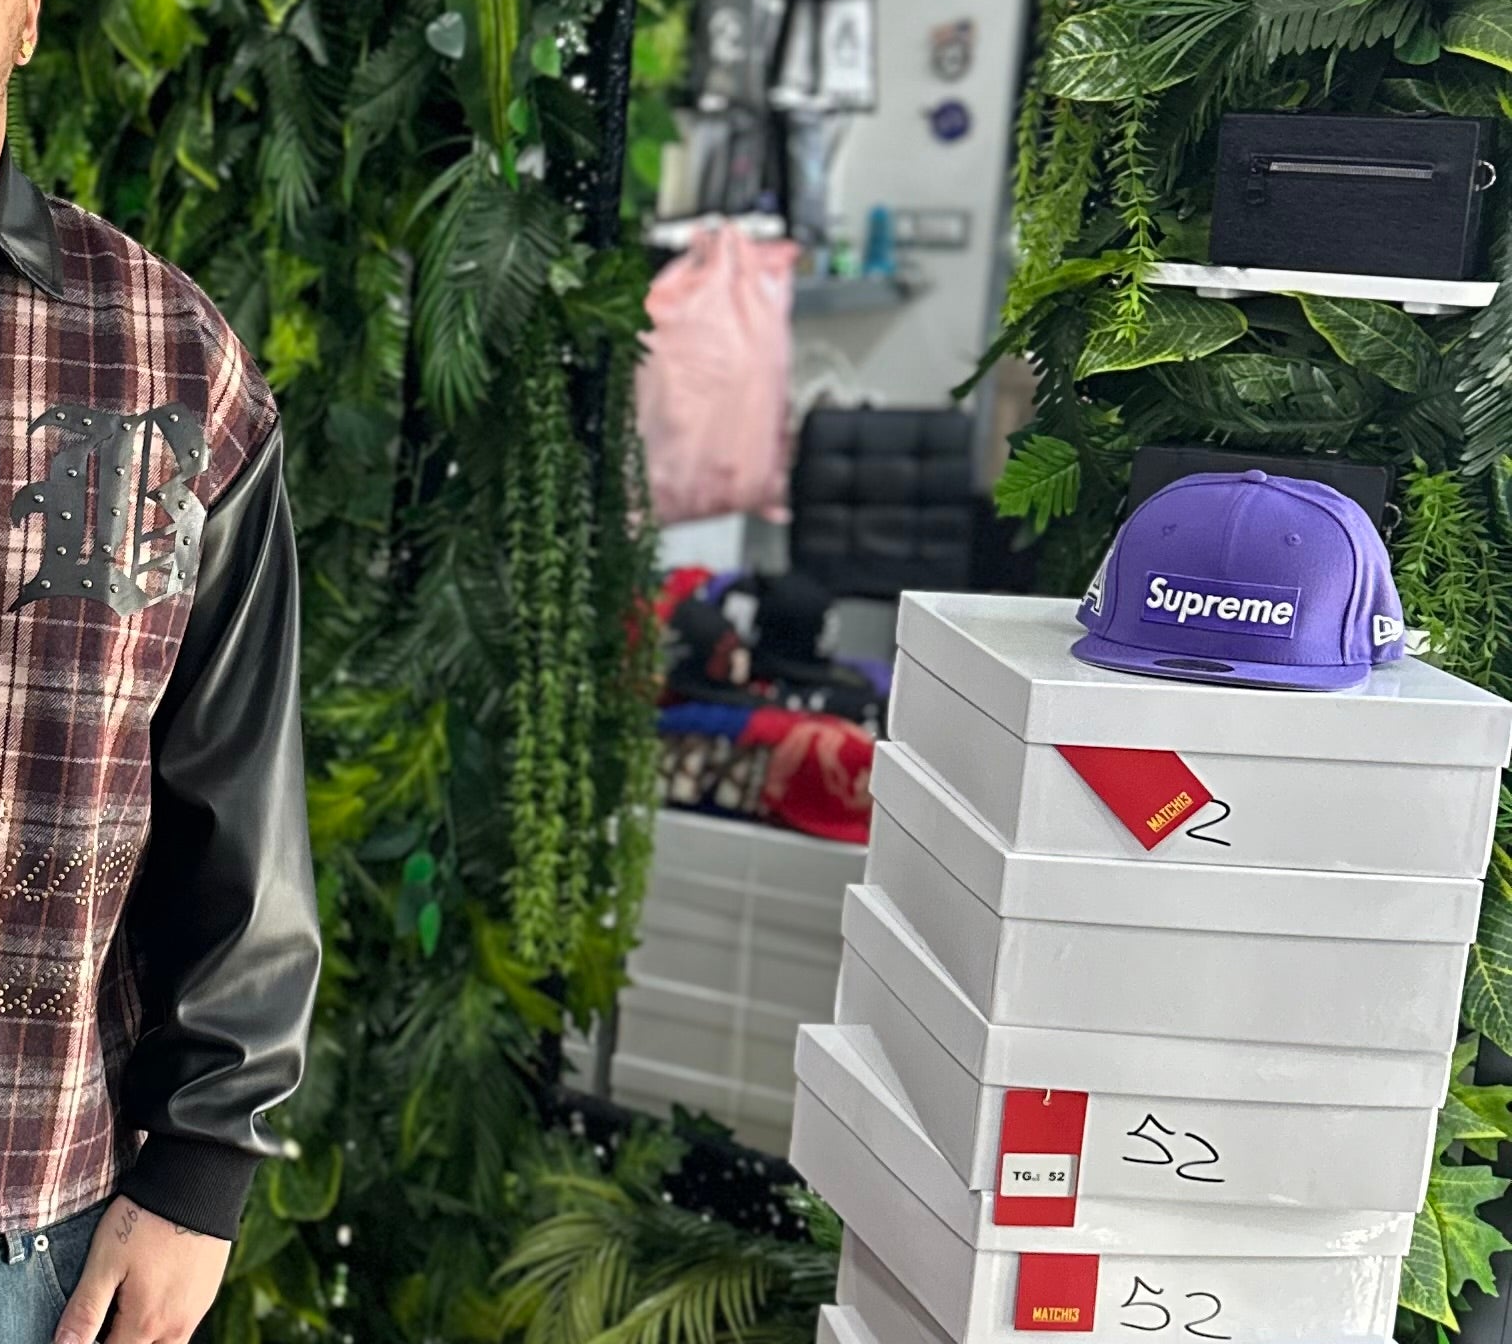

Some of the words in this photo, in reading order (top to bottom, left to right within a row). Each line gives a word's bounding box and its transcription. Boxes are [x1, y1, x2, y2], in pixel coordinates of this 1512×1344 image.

[1145, 576, 1294, 626] Supreme
[1146, 791, 1194, 833] MATCH13
[1122, 1113, 1225, 1183] 52
[1048, 1172, 1065, 1182] 52
[1032, 1306, 1080, 1323] MATCH13
[1121, 1276, 1232, 1340] 52
